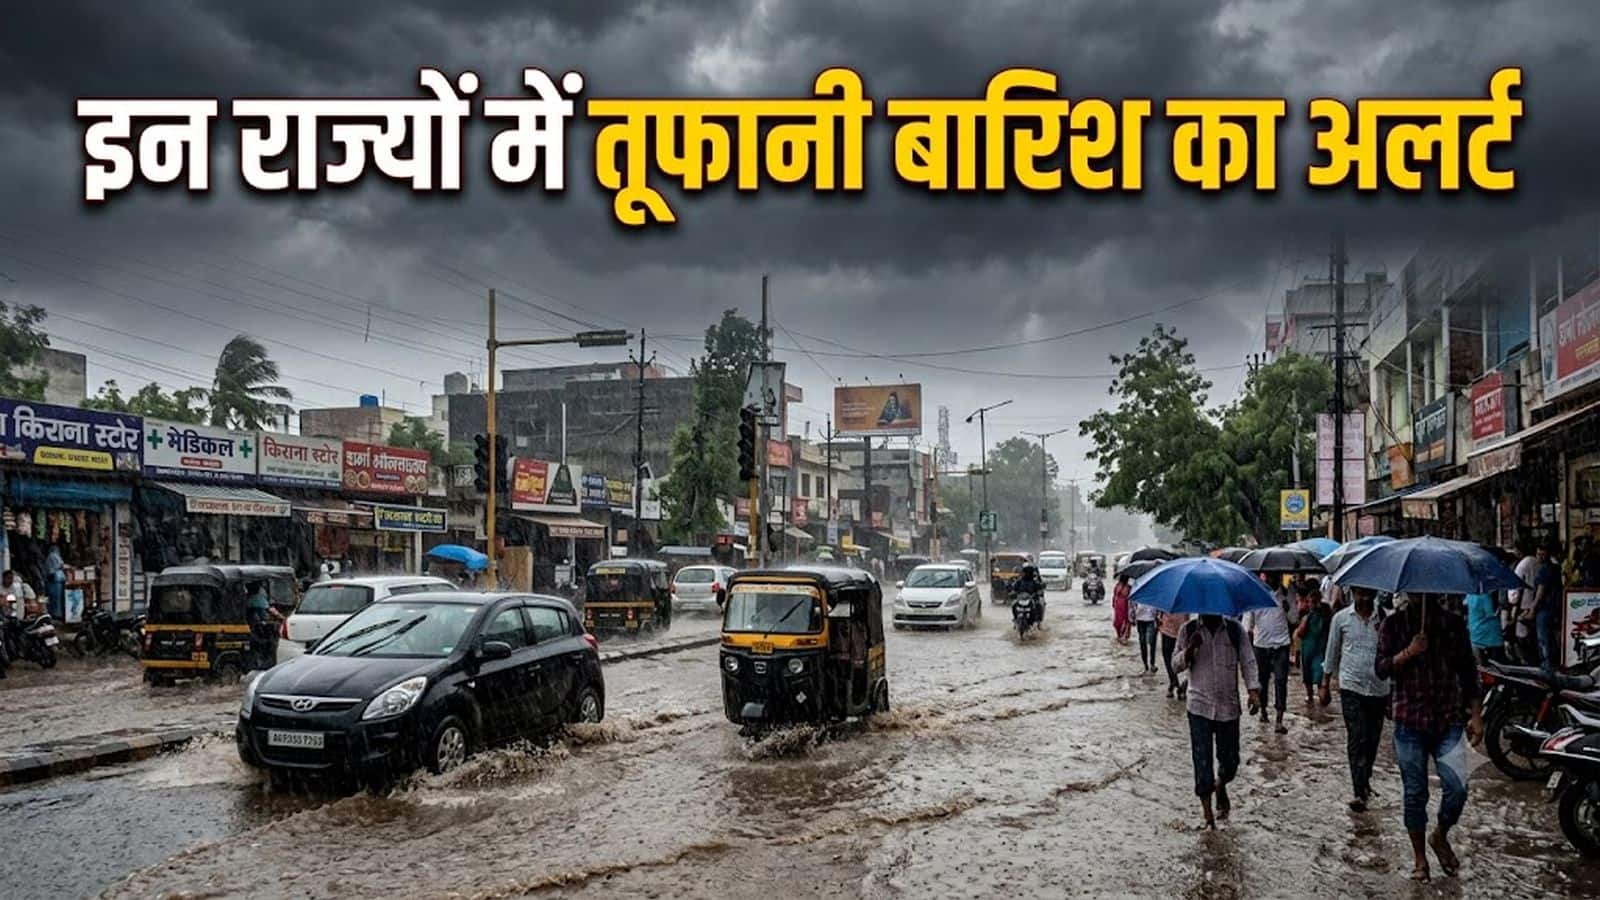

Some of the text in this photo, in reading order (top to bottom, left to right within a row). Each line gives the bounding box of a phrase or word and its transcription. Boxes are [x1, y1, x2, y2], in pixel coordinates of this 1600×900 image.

[13, 405, 90, 445] किराना
[95, 418, 140, 450] स्टोर
[166, 426, 235, 458] मेडिकल
[263, 436, 339, 465] किराना स्टोर
